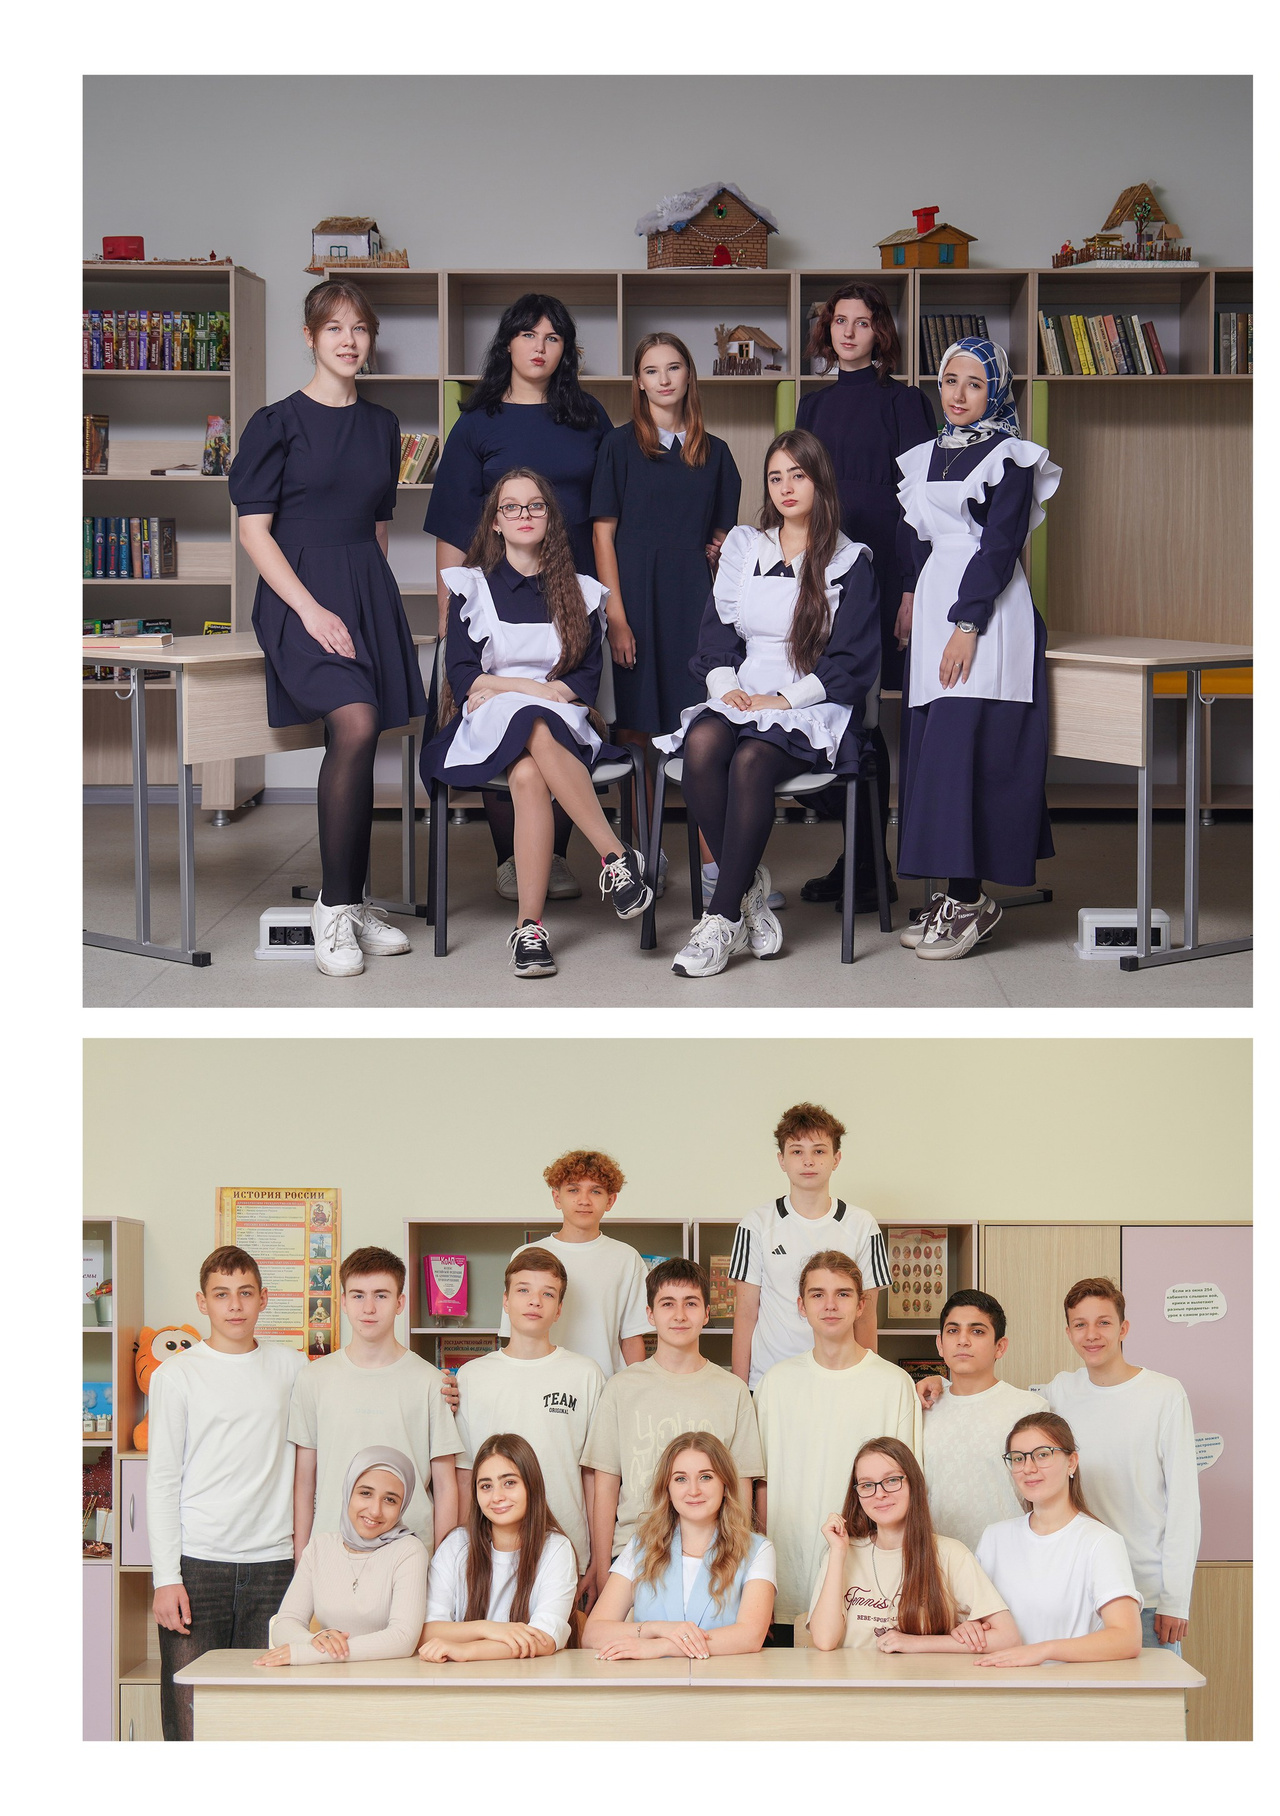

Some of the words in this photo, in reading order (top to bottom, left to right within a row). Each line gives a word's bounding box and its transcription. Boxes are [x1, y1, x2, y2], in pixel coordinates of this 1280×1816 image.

[233, 1191, 281, 1199] ИСТОРИЯ
[285, 1191, 325, 1200] РОССИИ
[543, 1392, 577, 1411] TEAM
[844, 1586, 889, 1611] Tennis
